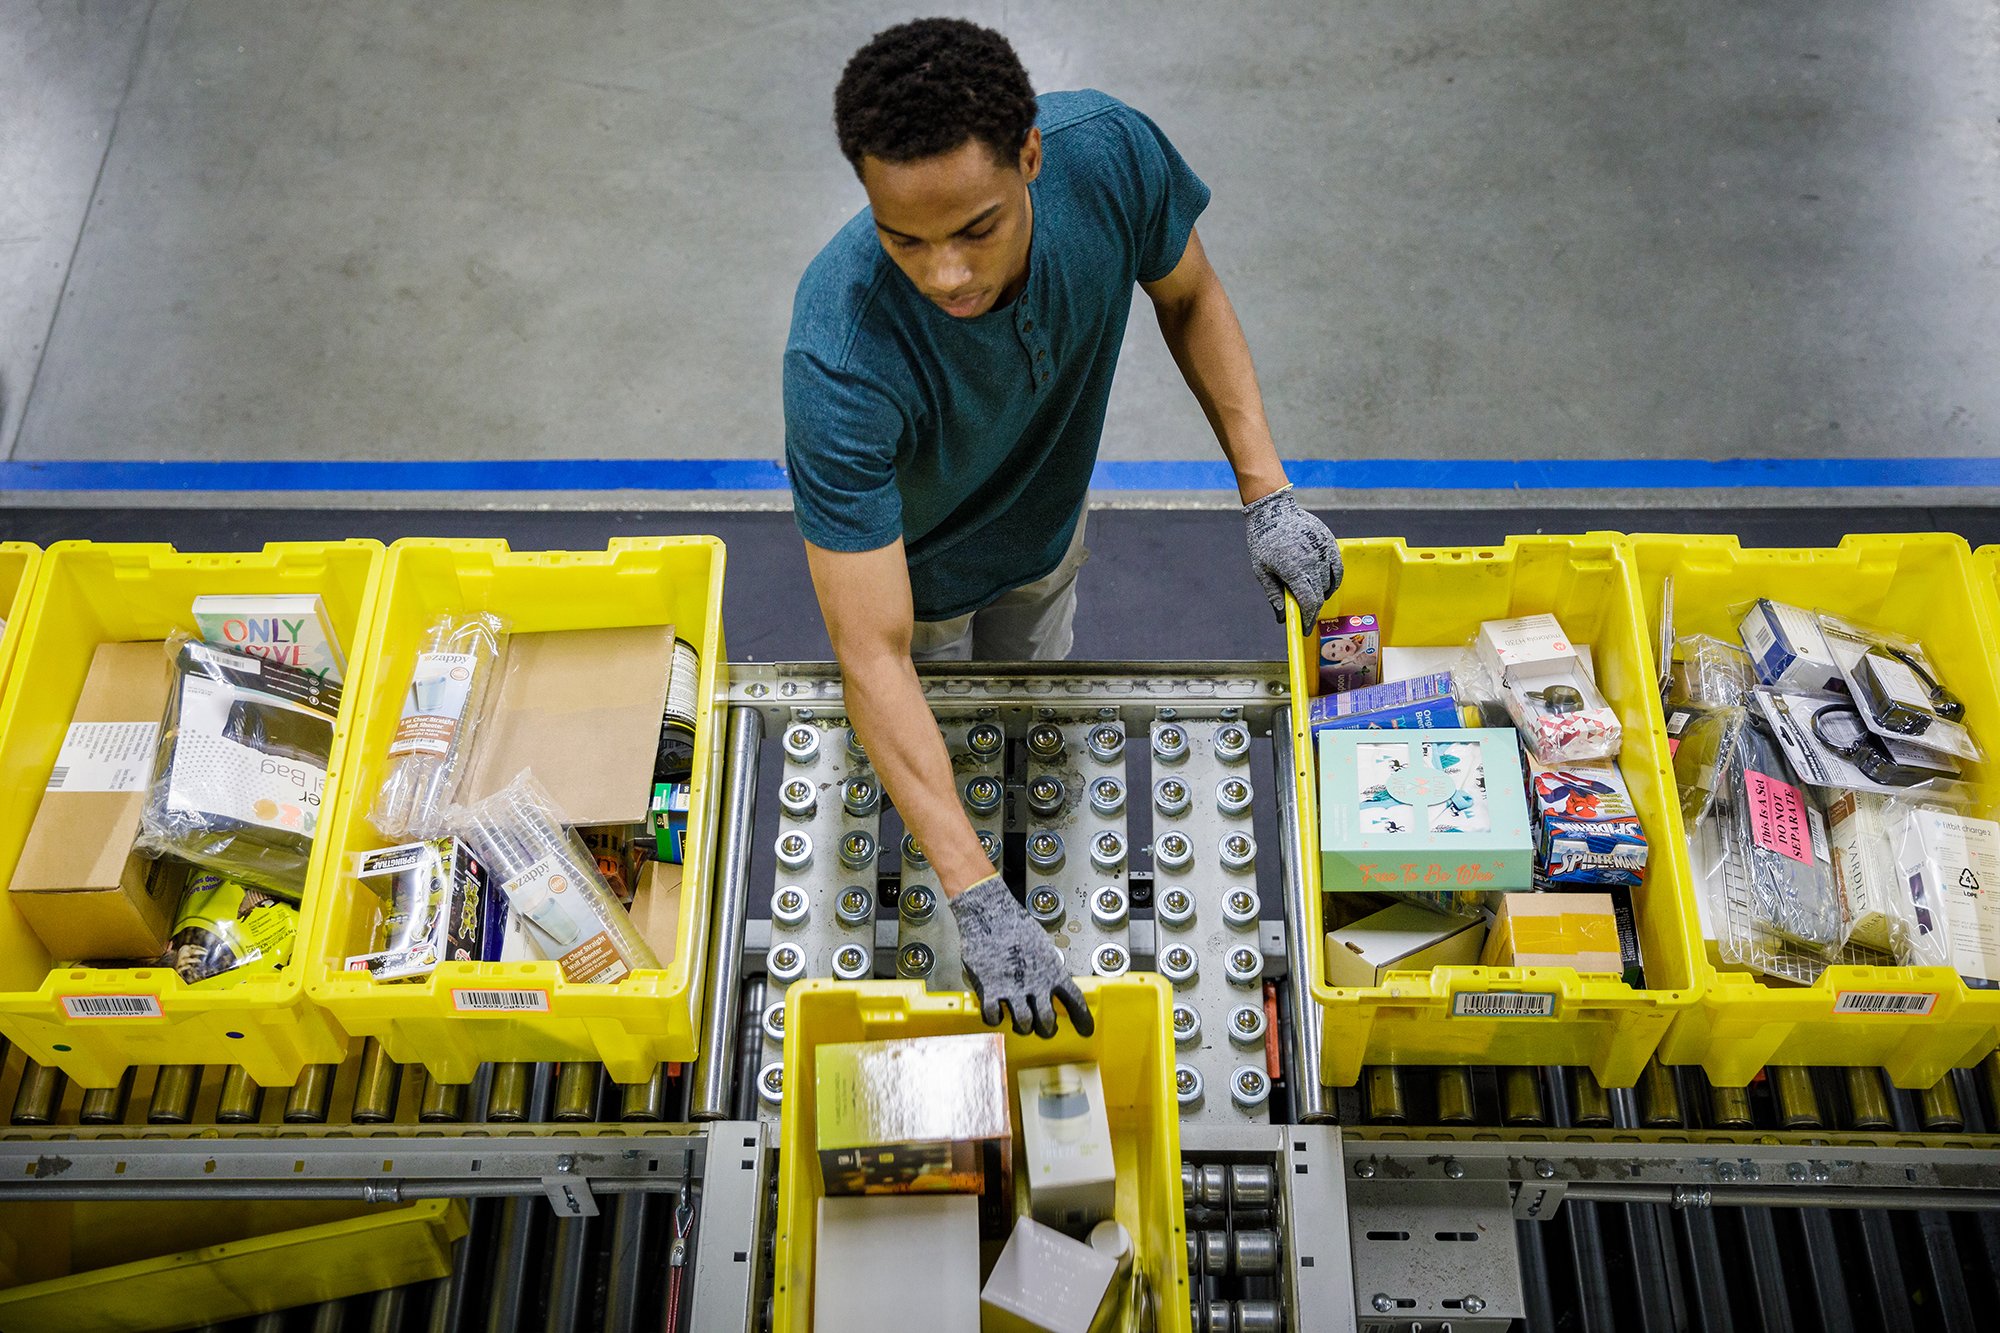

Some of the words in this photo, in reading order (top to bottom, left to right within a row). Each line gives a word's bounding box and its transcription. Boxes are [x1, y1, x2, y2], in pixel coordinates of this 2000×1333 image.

[222, 618, 305, 644] ONLY
[431, 653, 470, 664] zappy
[260, 759, 306, 788] Bag
[1755, 779, 1766, 796] Set
[1758, 799, 1767, 808] A
[1759, 809, 1769, 820] Is
[1773, 793, 1785, 823] NOT
[1761, 820, 1772, 845] This
[1777, 824, 1788, 845] DO
[1784, 789, 1803, 859] SEPARATE
[373, 854, 418, 869] SPRINGTRAP
[1359, 862, 1398, 884] Free
[1400, 863, 1419, 882] To
[1424, 864, 1452, 884] Be
[517, 860, 551, 889] zappy
[1848, 840, 1867, 912] YARDLEY
